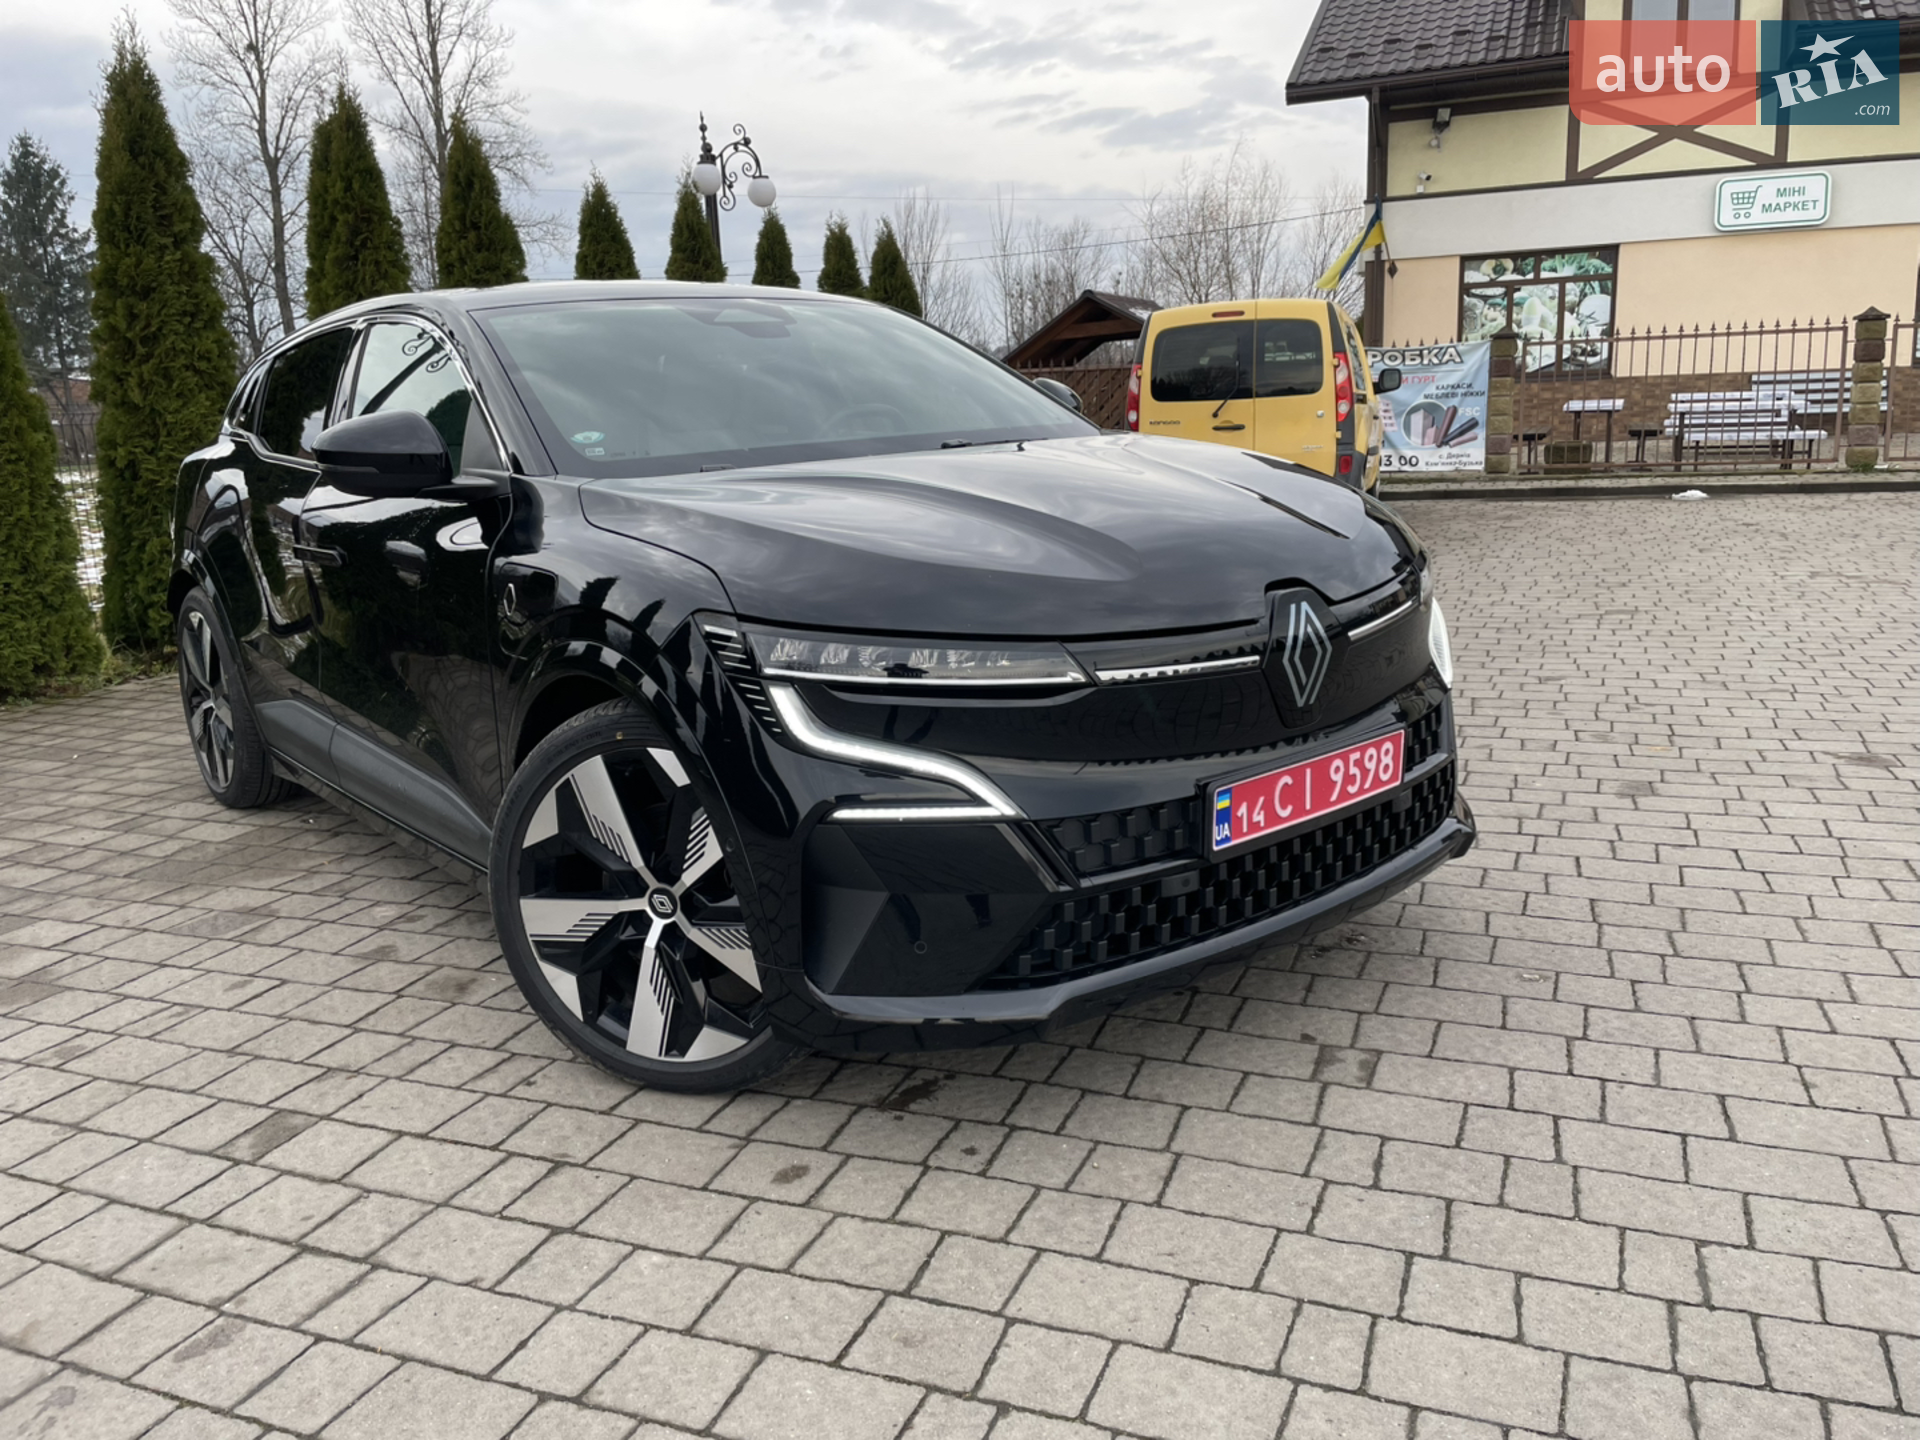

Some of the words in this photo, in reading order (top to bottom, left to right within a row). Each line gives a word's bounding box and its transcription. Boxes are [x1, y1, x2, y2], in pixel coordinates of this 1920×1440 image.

[1776, 186, 1806, 199] МІНІ
[1761, 199, 1820, 215] МАРКЕТ
[1458, 406, 1481, 417] FSC
[1236, 796, 1265, 833] 14
[1329, 741, 1394, 802] 9598
[1215, 822, 1231, 841] UA
